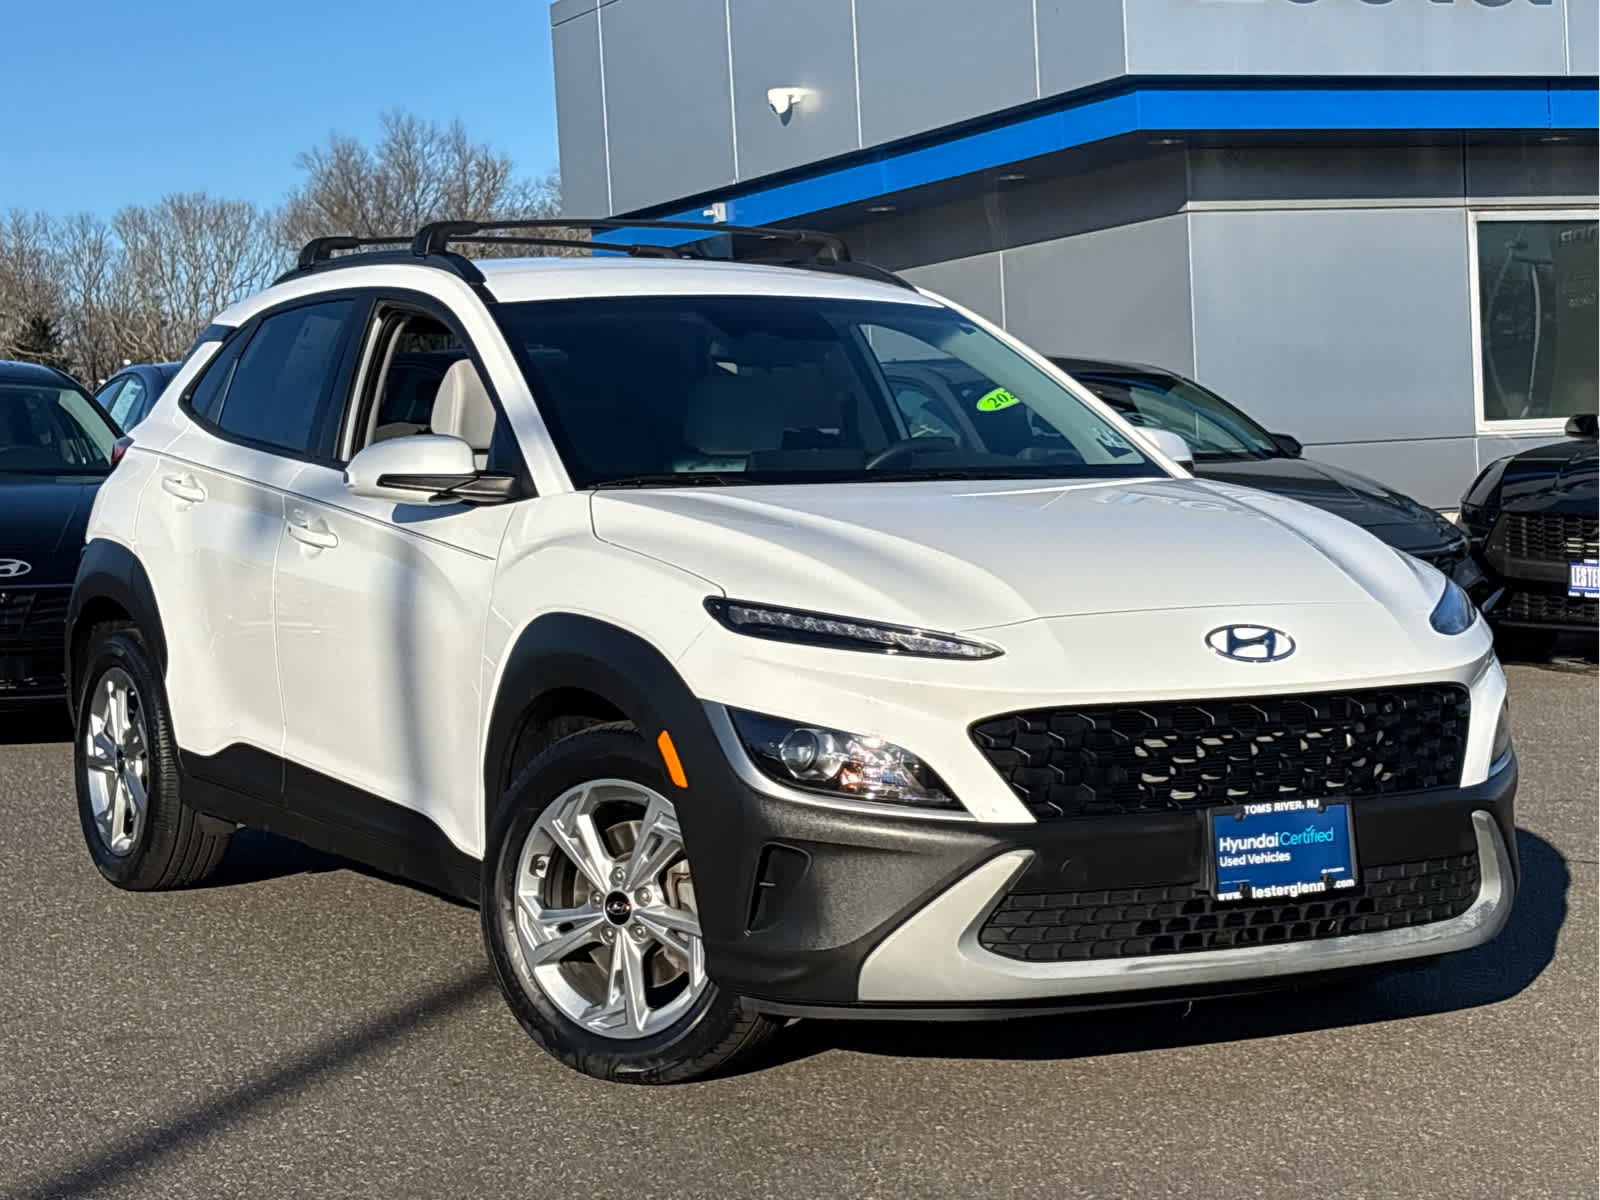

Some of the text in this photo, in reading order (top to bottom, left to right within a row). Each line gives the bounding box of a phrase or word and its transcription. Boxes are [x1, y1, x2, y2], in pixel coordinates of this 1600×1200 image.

[1571, 567, 1599, 587] LESTE
[1244, 803, 1272, 815] TOMS
[1306, 799, 1319, 808] NJ
[1219, 851, 1291, 867] Used Vehicles
